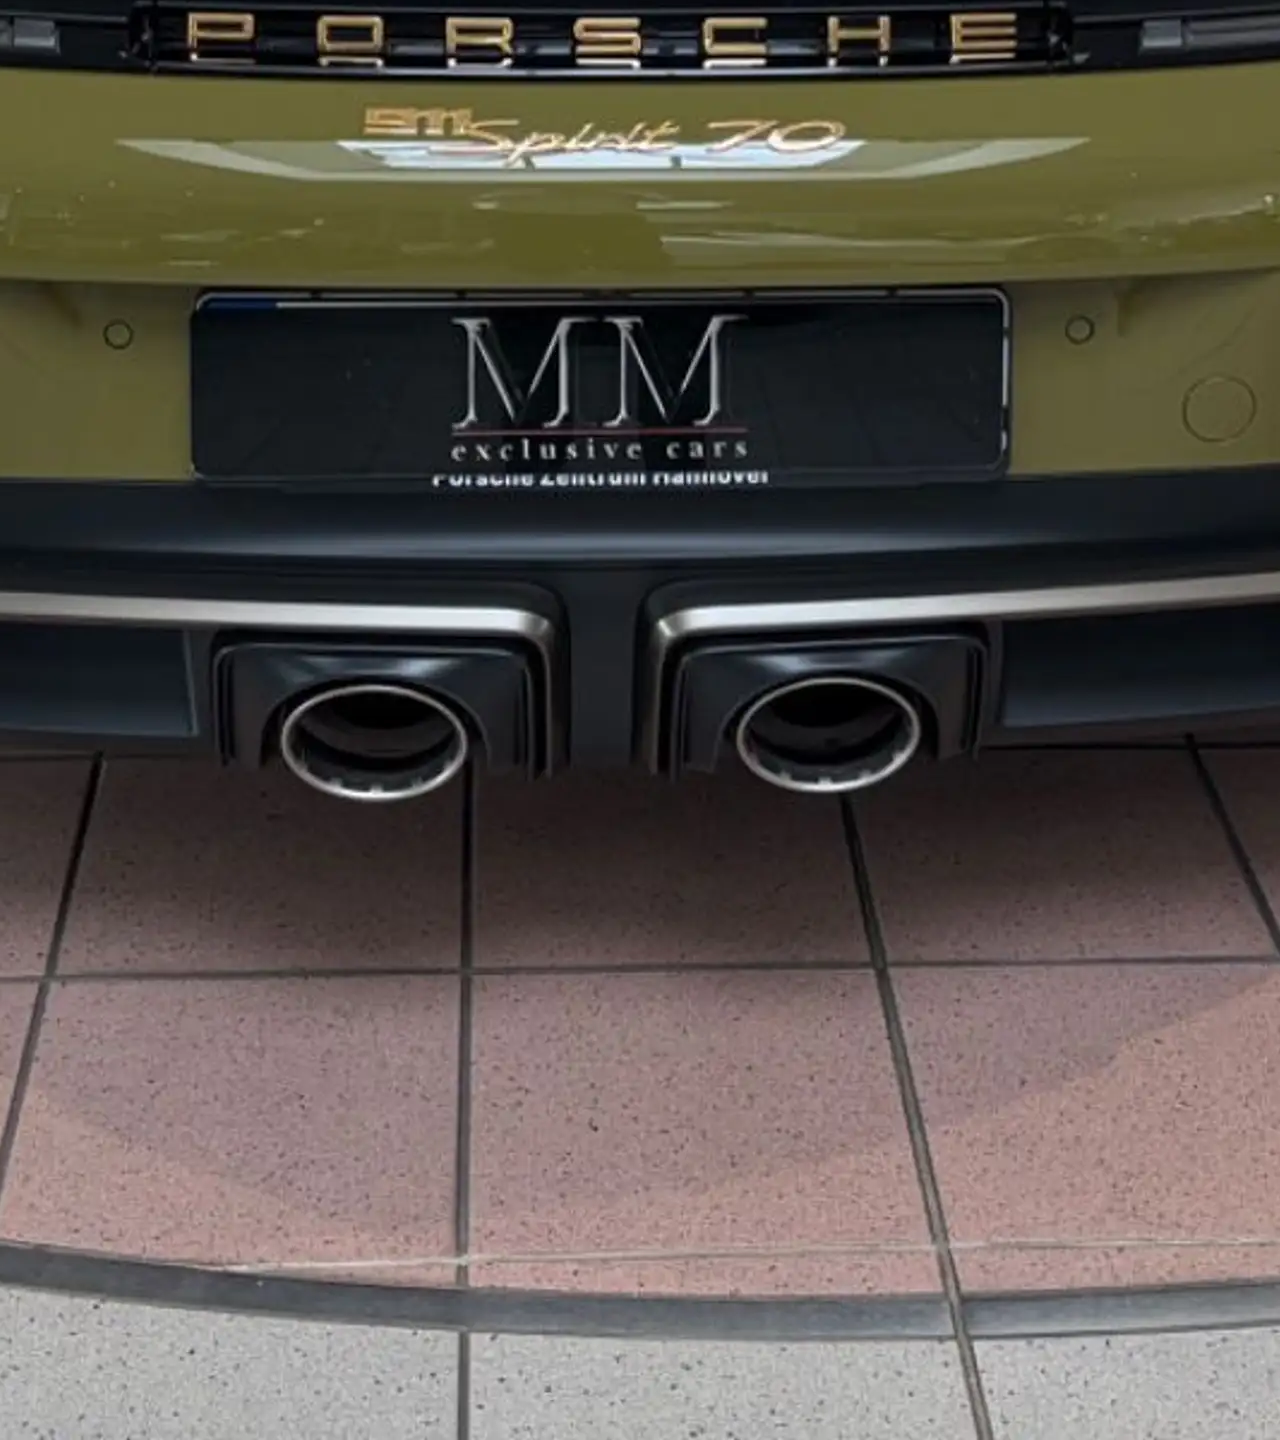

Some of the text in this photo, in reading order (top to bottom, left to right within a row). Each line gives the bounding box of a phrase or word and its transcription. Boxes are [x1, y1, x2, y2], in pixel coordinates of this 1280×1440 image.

[188, 12, 1017, 60] PORSCHE
[466, 118, 680, 169] Spirit
[706, 120, 847, 153] 70
[451, 313, 750, 429] MM
[450, 437, 749, 462] exclusive cars
